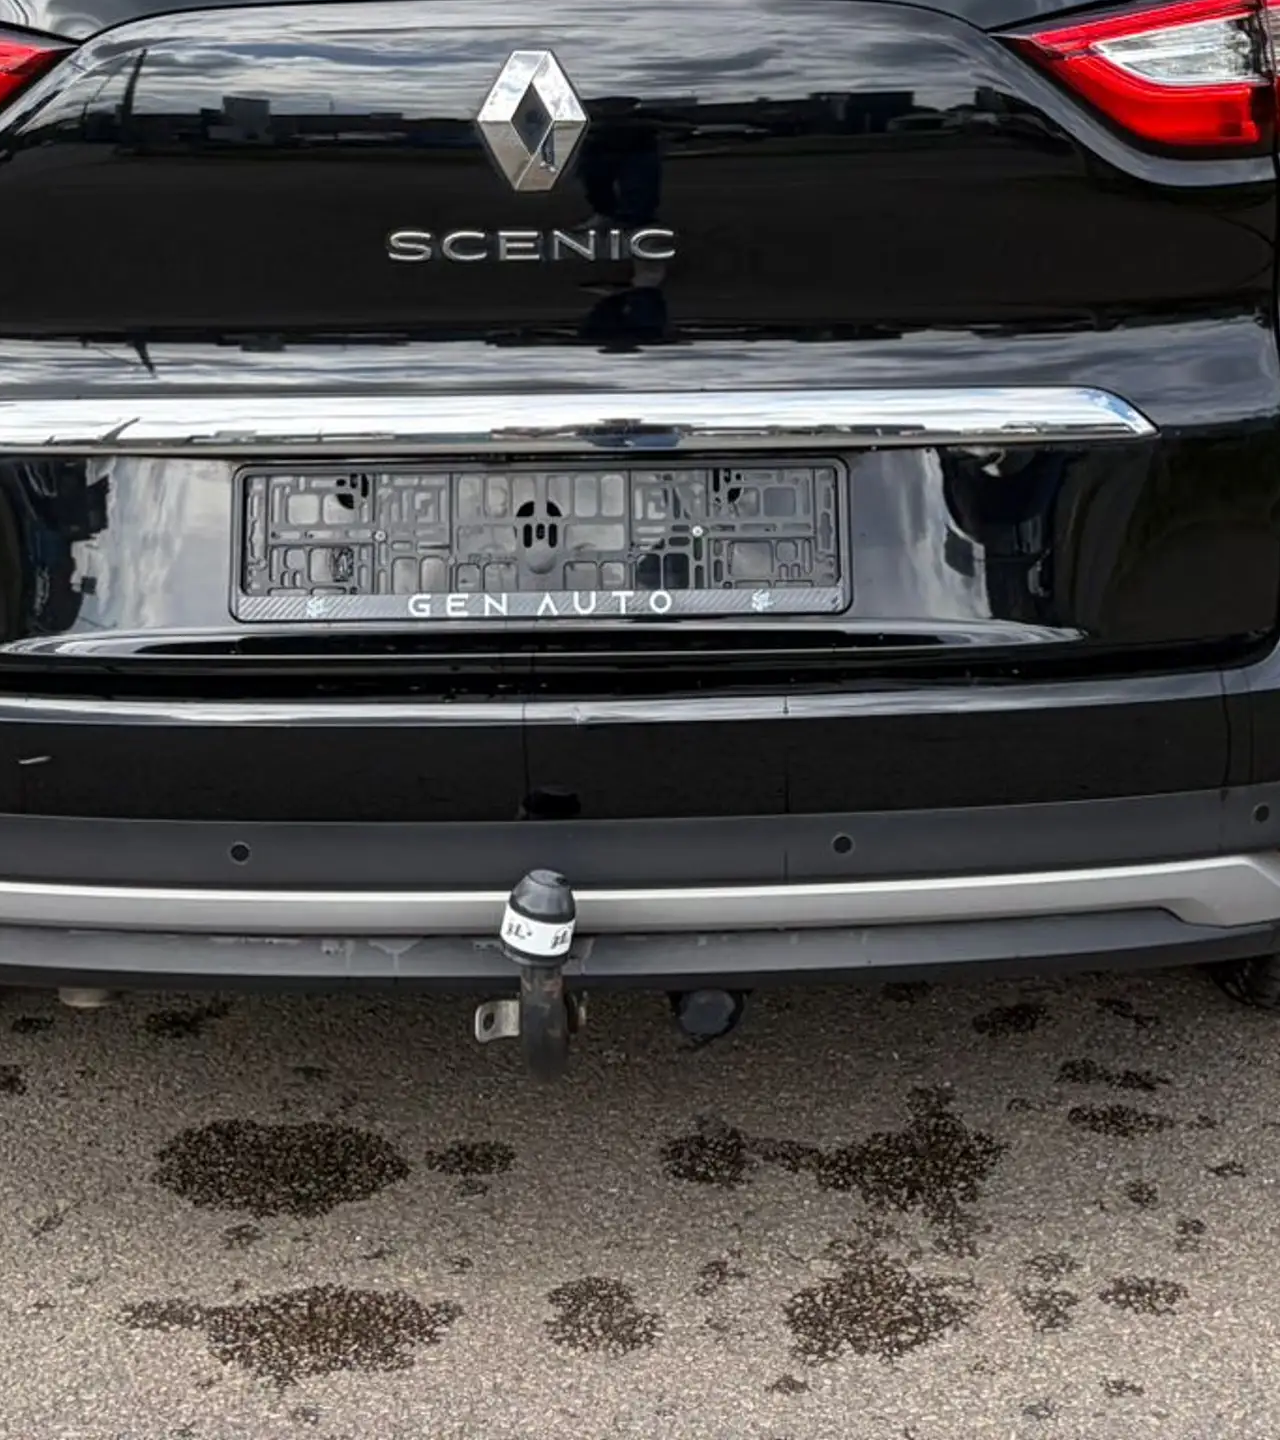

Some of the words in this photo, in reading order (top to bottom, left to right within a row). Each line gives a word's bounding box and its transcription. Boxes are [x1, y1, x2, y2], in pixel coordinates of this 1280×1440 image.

[388, 228, 676, 261] SCENIC
[407, 592, 508, 618] GEN
[536, 589, 673, 617] AUTO
